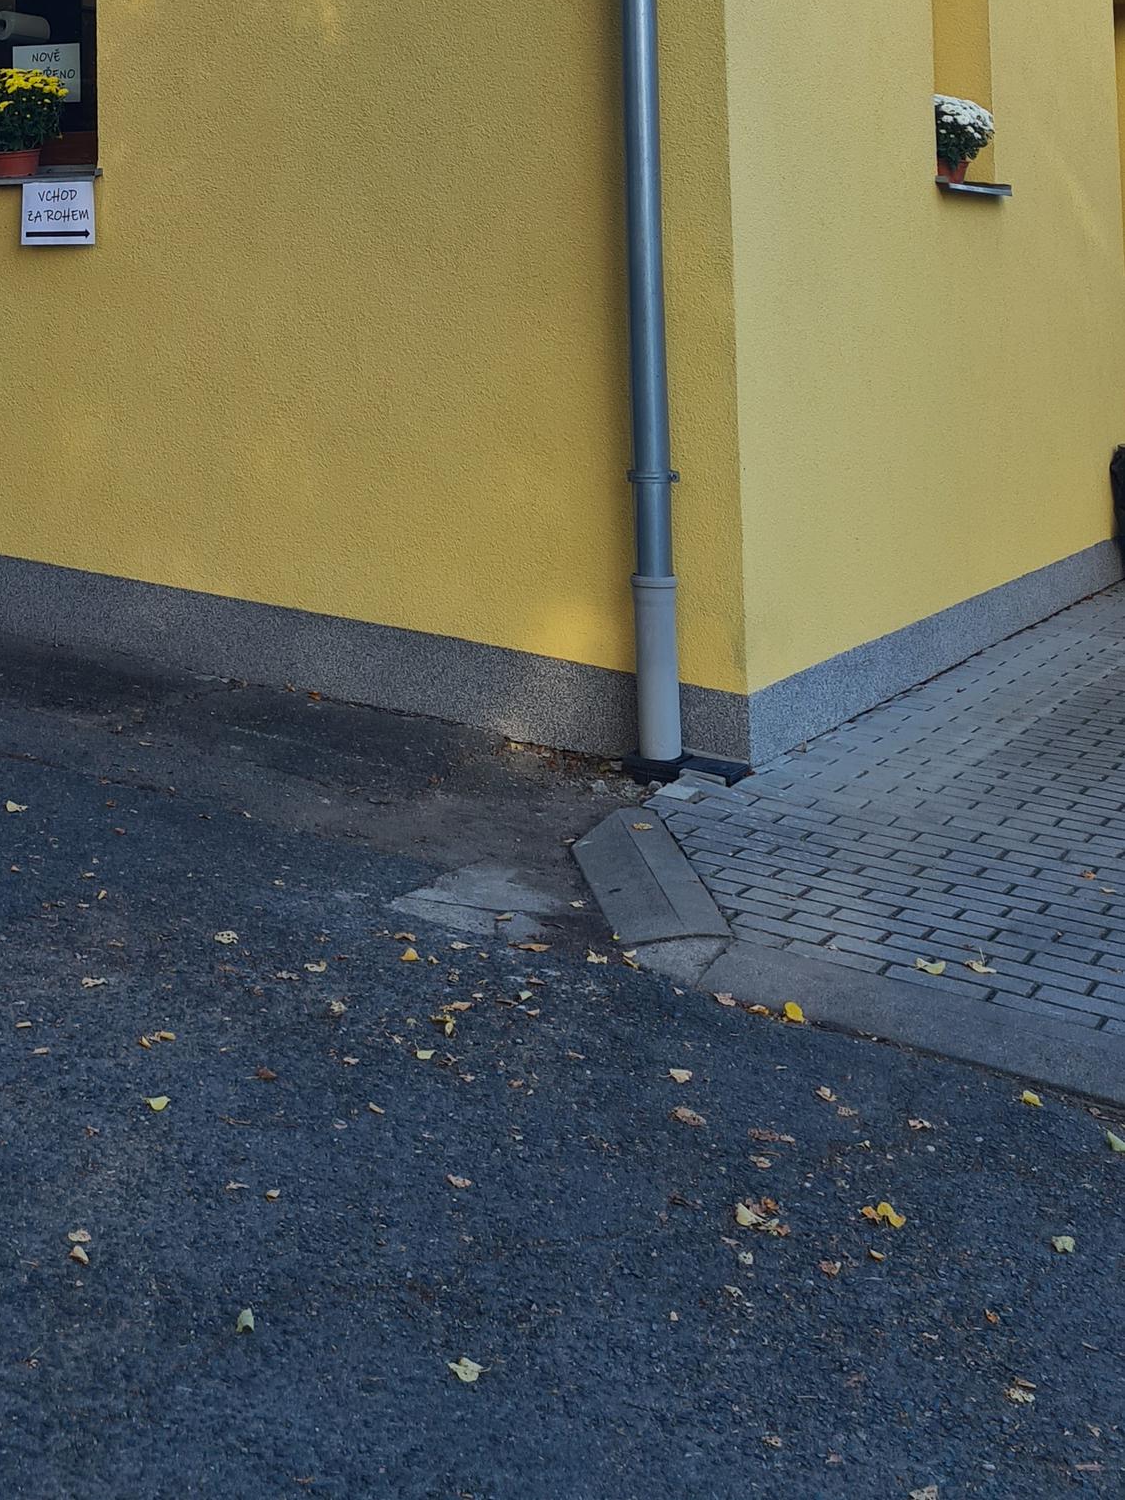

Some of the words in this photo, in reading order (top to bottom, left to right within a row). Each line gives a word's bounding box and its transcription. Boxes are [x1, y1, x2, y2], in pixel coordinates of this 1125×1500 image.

[38, 188, 77, 202] VCHOD
[27, 210, 42, 223] ZA
[44, 208, 89, 222] ROHEM
